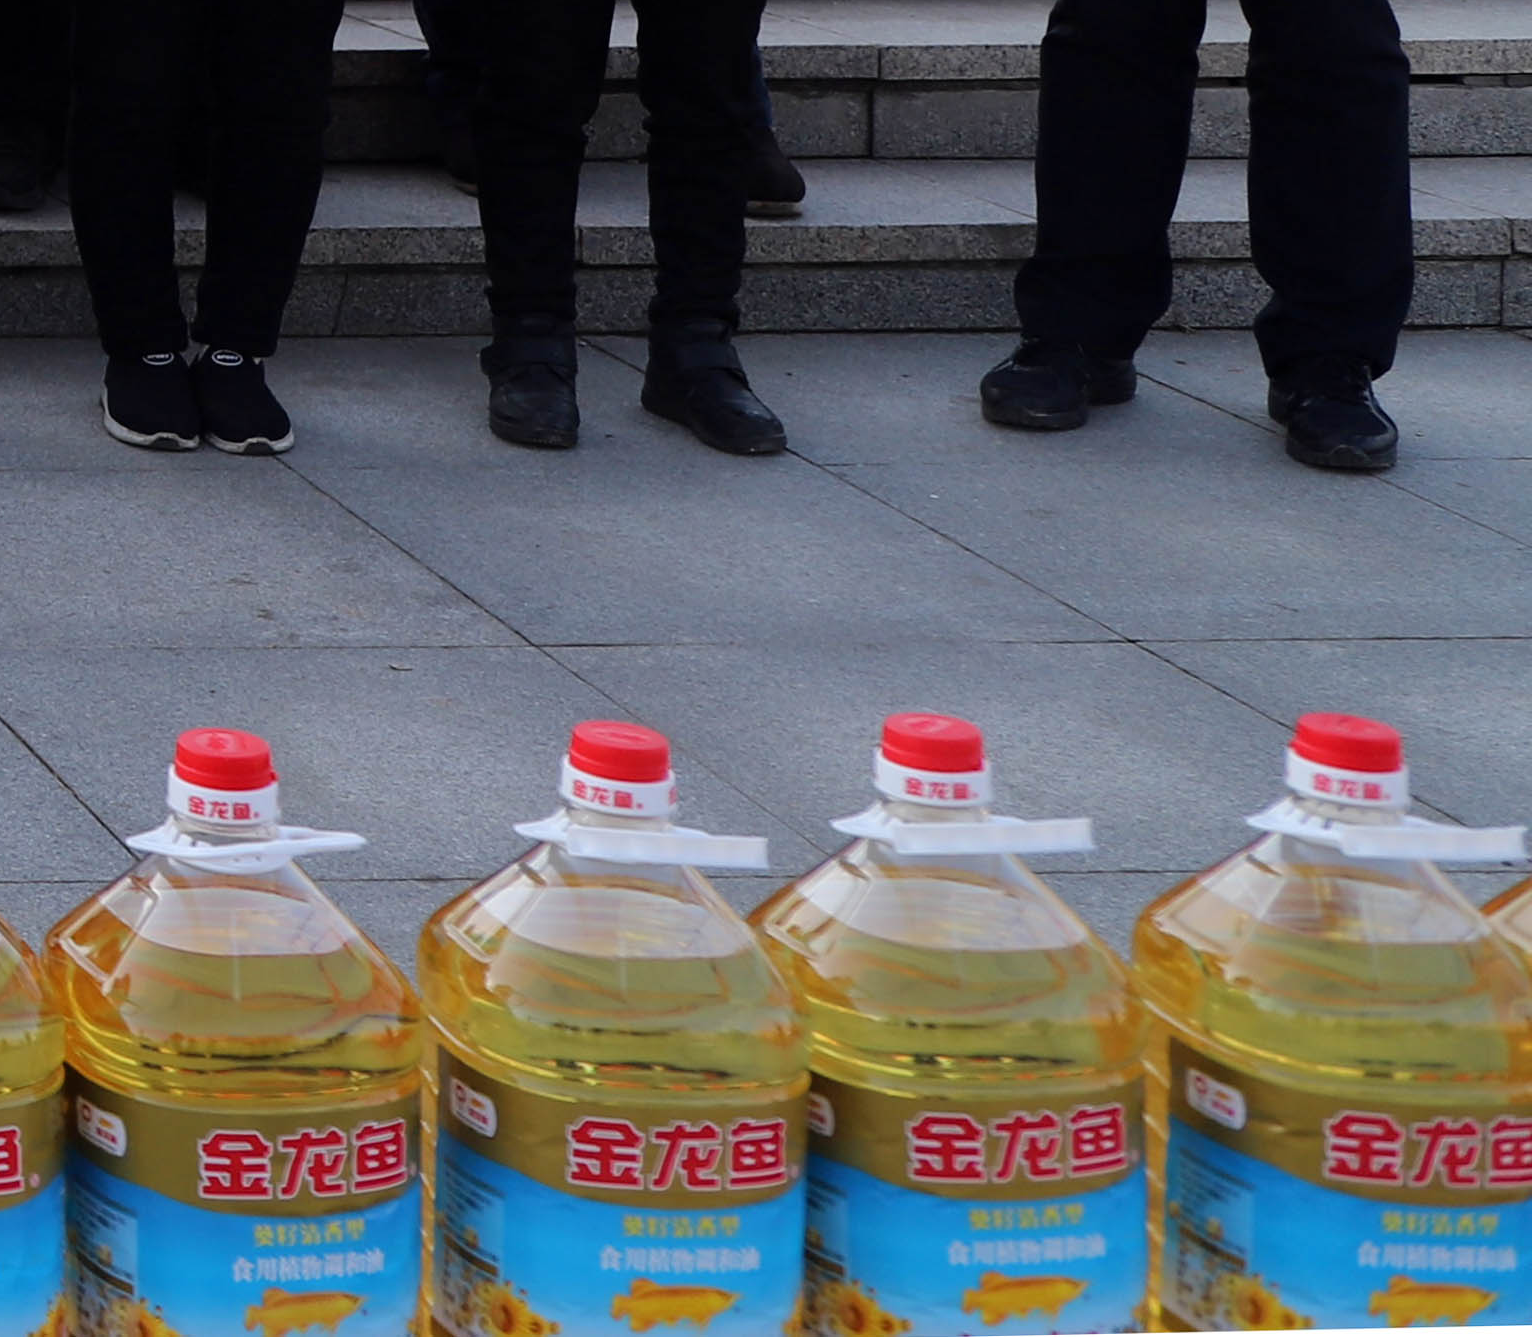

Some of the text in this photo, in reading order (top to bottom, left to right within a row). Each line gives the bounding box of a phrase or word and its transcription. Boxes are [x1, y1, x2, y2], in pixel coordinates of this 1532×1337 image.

[572, 788, 634, 811] 金龙鱼
[906, 776, 971, 800] 金龙鱼
[188, 796, 252, 821] 金龙鱼
[199, 1119, 410, 1200] 金龙鱼
[568, 1117, 788, 1191] 金龙鱼
[908, 1104, 1129, 1183] 金龙鱼
[231, 1248, 385, 1283] 食用植物调和油
